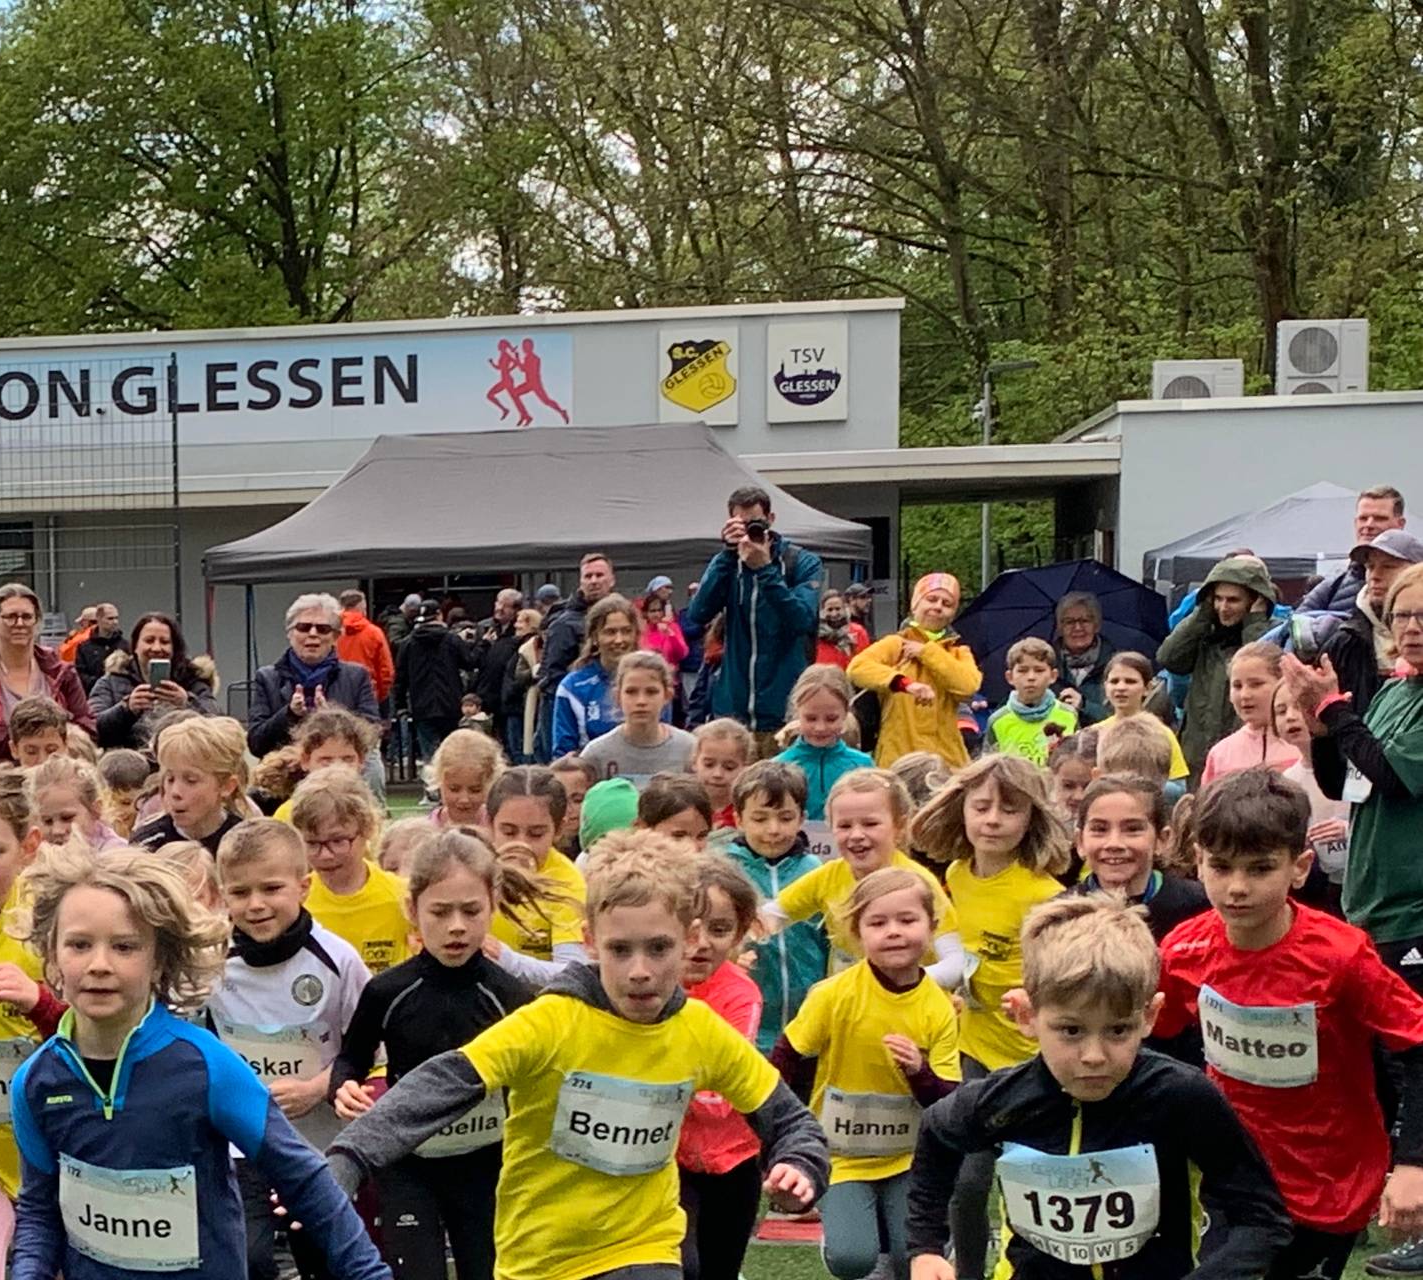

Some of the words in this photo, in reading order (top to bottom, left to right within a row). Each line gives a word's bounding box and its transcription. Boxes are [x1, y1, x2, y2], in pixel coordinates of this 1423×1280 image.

[664, 347, 723, 392] GLESSEN
[789, 347, 825, 364] TSV
[111, 353, 420, 416] GLESSEN
[778, 379, 836, 394] GLESSEN
[1206, 1019, 1307, 1060] Matteo
[568, 1110, 673, 1147] Bennet
[833, 1116, 910, 1137] Hanna
[76, 1203, 171, 1240] Janne
[1023, 1190, 1137, 1234] 1379
[1072, 1247, 1088, 1260] 10
[1095, 1243, 1113, 1257] W
[1125, 1241, 1134, 1253] 5
